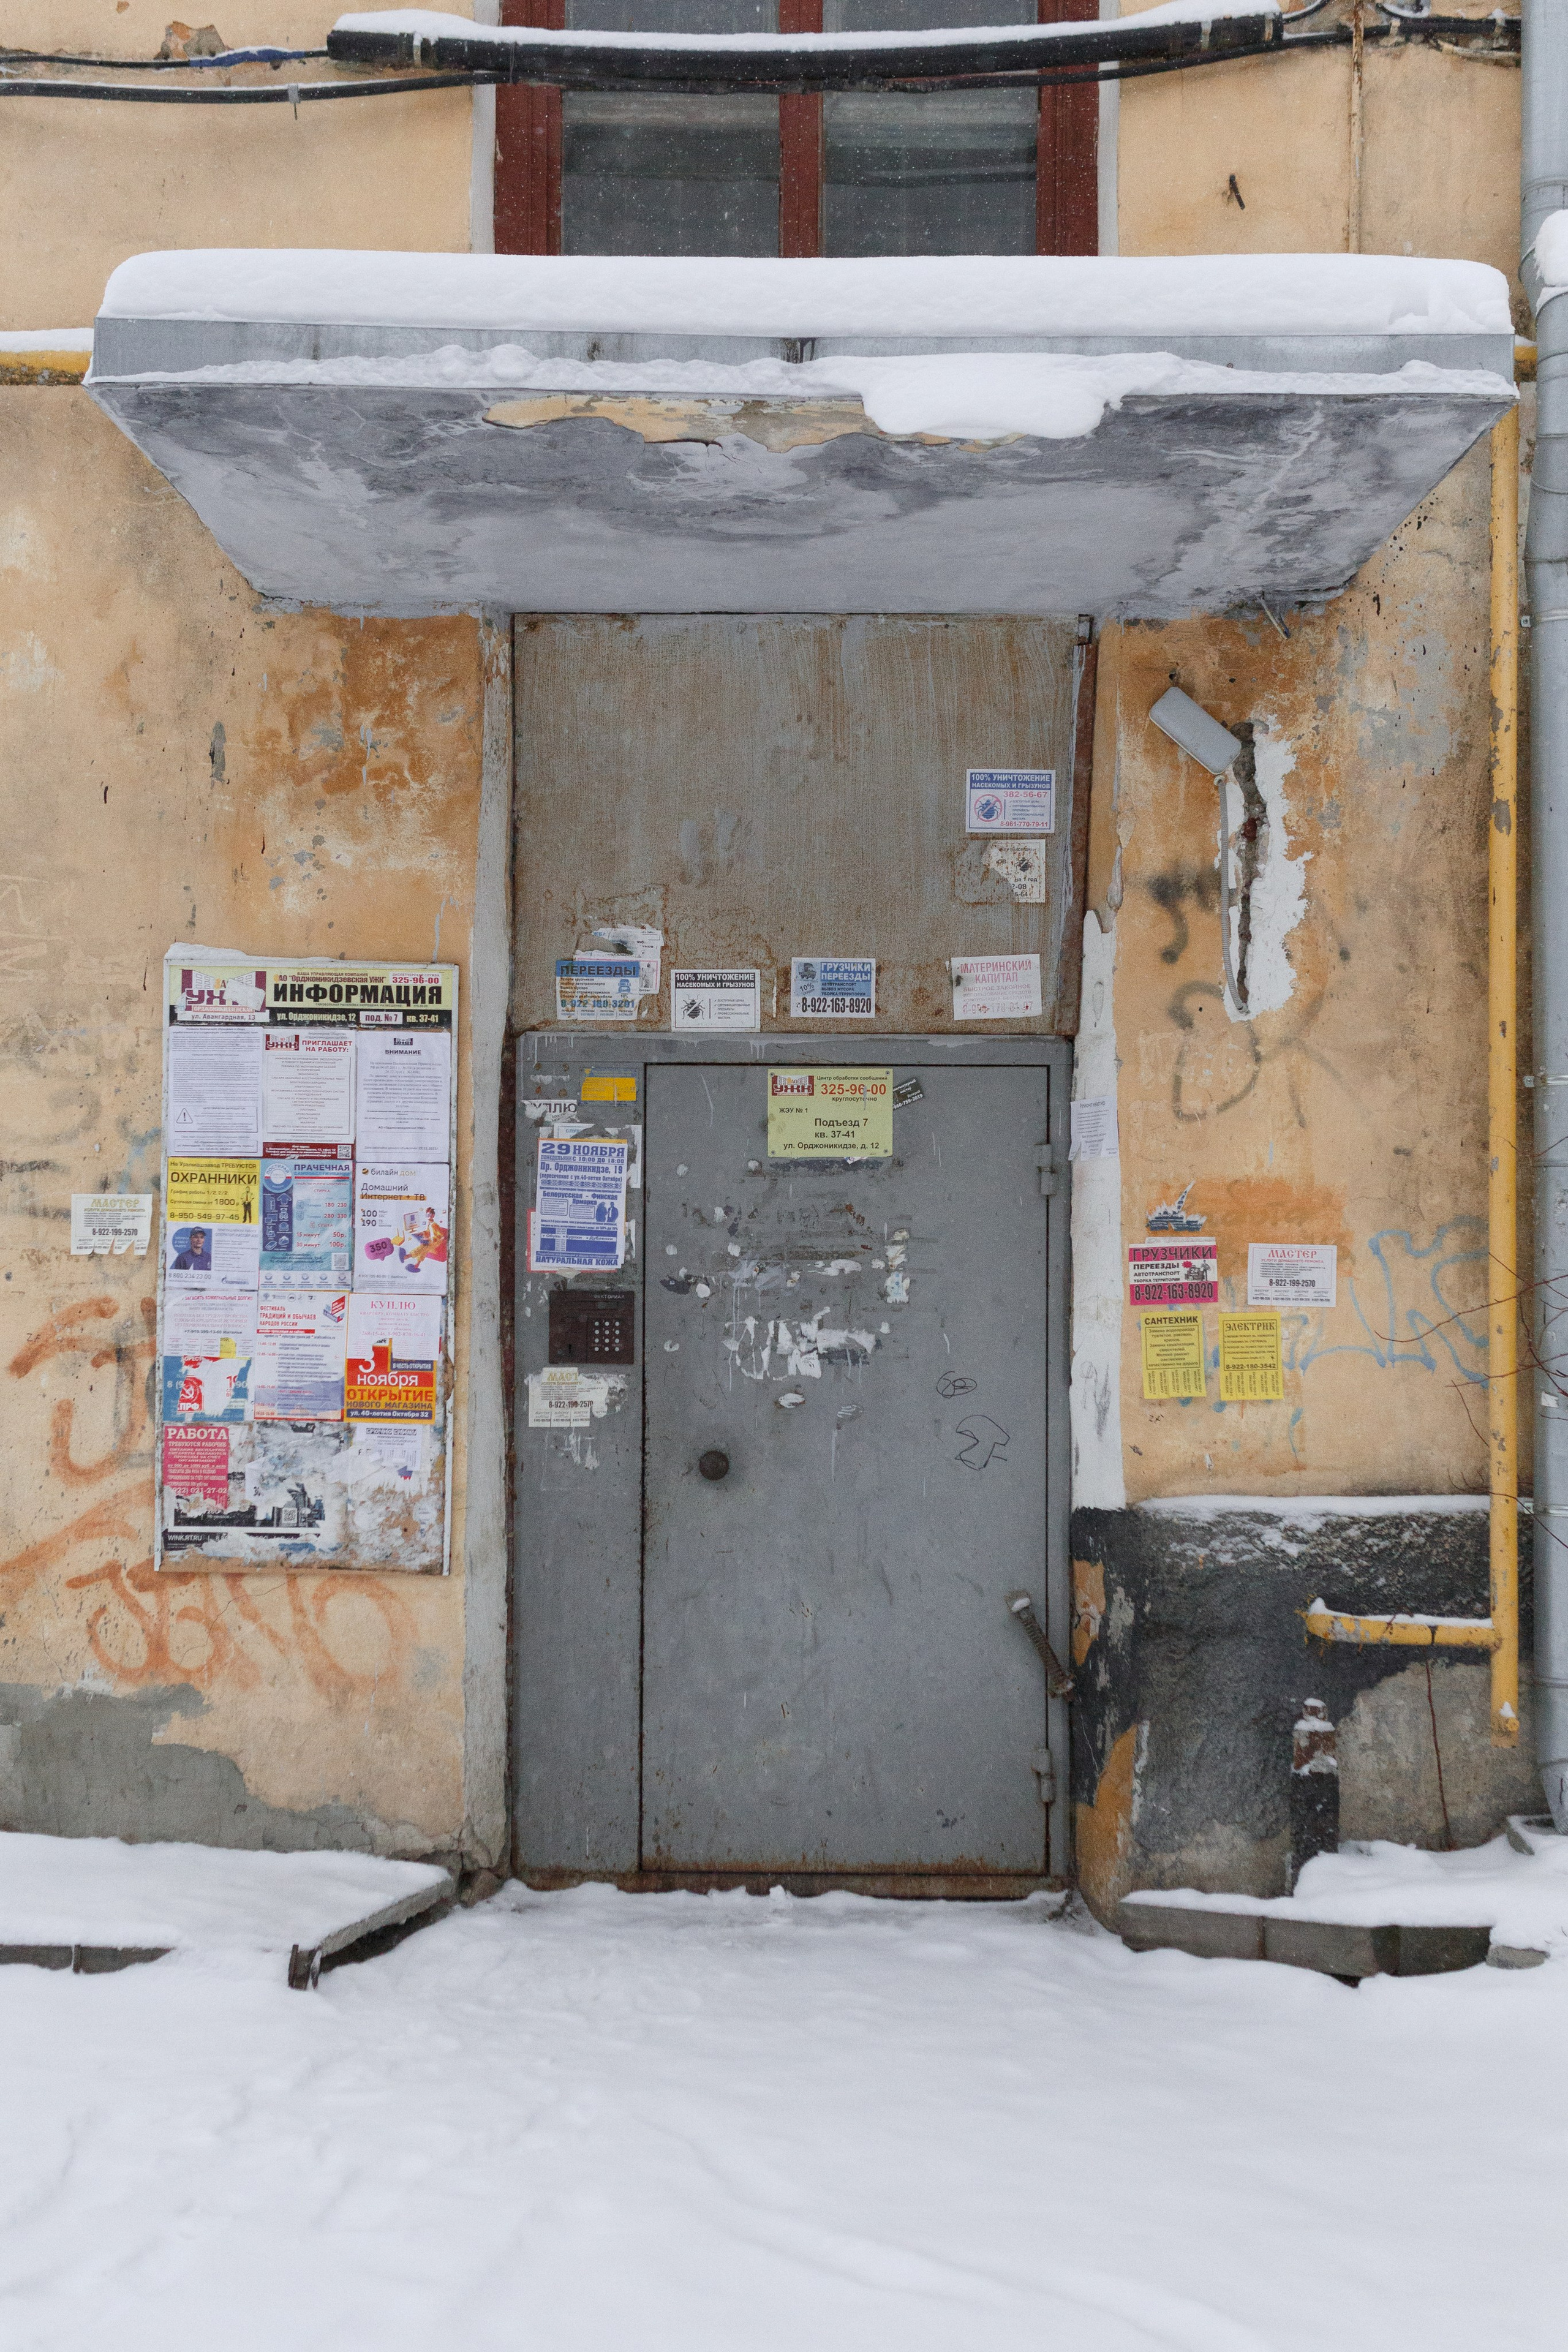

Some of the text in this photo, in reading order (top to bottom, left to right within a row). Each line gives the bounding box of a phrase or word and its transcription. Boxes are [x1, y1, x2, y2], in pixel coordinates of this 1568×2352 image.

[560, 966, 636, 977] ПЕРЕЕЗДЫ
[821, 963, 870, 971] ГРУЗЧИКИ
[960, 959, 1031, 973] МАТЕРИНСКИЙ
[821, 973, 871, 981] ПЕРЕЕЗДЫ
[974, 972, 1018, 984] КАПИТАЛ
[799, 982, 814, 992] 10%
[274, 984, 442, 1006] ИНФОРМАЦИЯ
[802, 997, 872, 1013] 8-922-163-8920
[288, 1012, 347, 1022] Орджоникидзе,
[365, 1014, 383, 1023] под.
[774, 1085, 812, 1093] УЖК
[821, 1084, 886, 1095] 325-96-00
[815, 1118, 860, 1128] Подъезд
[541, 1143, 625, 1156] 29 НОЯБРЯ
[540, 1162, 623, 1175] Пр. Орджоникидзе, 19
[171, 1172, 257, 1184] ОХРАННИКИ
[361, 1183, 409, 1191] Домашний
[90, 1199, 140, 1208] МАСТЕР
[369, 1242, 387, 1253] 350
[1133, 1246, 1212, 1261] ГРУЗЧИКИ
[1268, 1250, 1317, 1259] МАСТЕР
[535, 1256, 593, 1265] НАТУРАЛЬНАЯ
[1134, 1283, 1213, 1300] 8-922-163-8920
[371, 1300, 416, 1310] КУПЛЮ
[1144, 1316, 1199, 1325] САНТЕХНИК
[1225, 1322, 1276, 1332] ЭЛЕКТРИК
[357, 1371, 418, 1389] ноября
[347, 1389, 433, 1401] ОТКРЫТИЕ
[167, 1428, 228, 1439] РАБОТА
